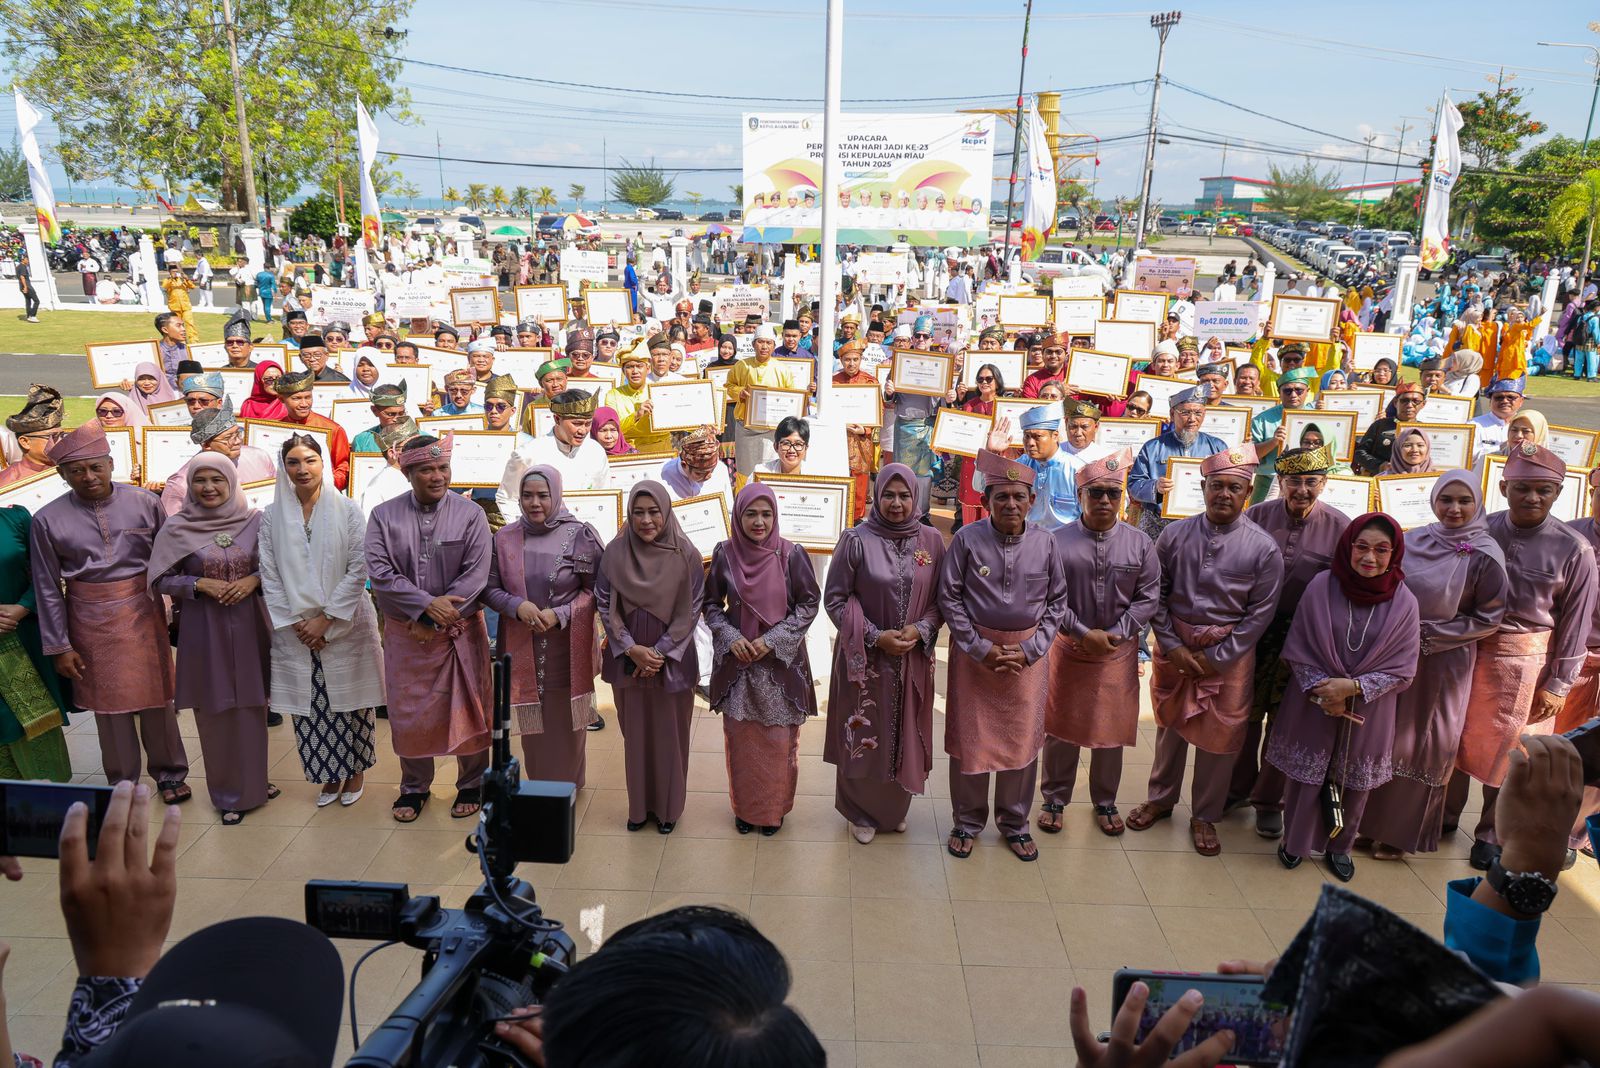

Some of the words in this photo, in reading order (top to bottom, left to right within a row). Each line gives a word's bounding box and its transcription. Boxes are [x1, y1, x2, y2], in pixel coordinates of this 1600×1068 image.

[961, 137, 987, 145] Kepri
[861, 143, 882, 151] HARI
[884, 143, 904, 151] JADI
[905, 143, 929, 151] KE-23
[842, 160, 871, 168] TAHUN
[872, 160, 892, 168] 2025
